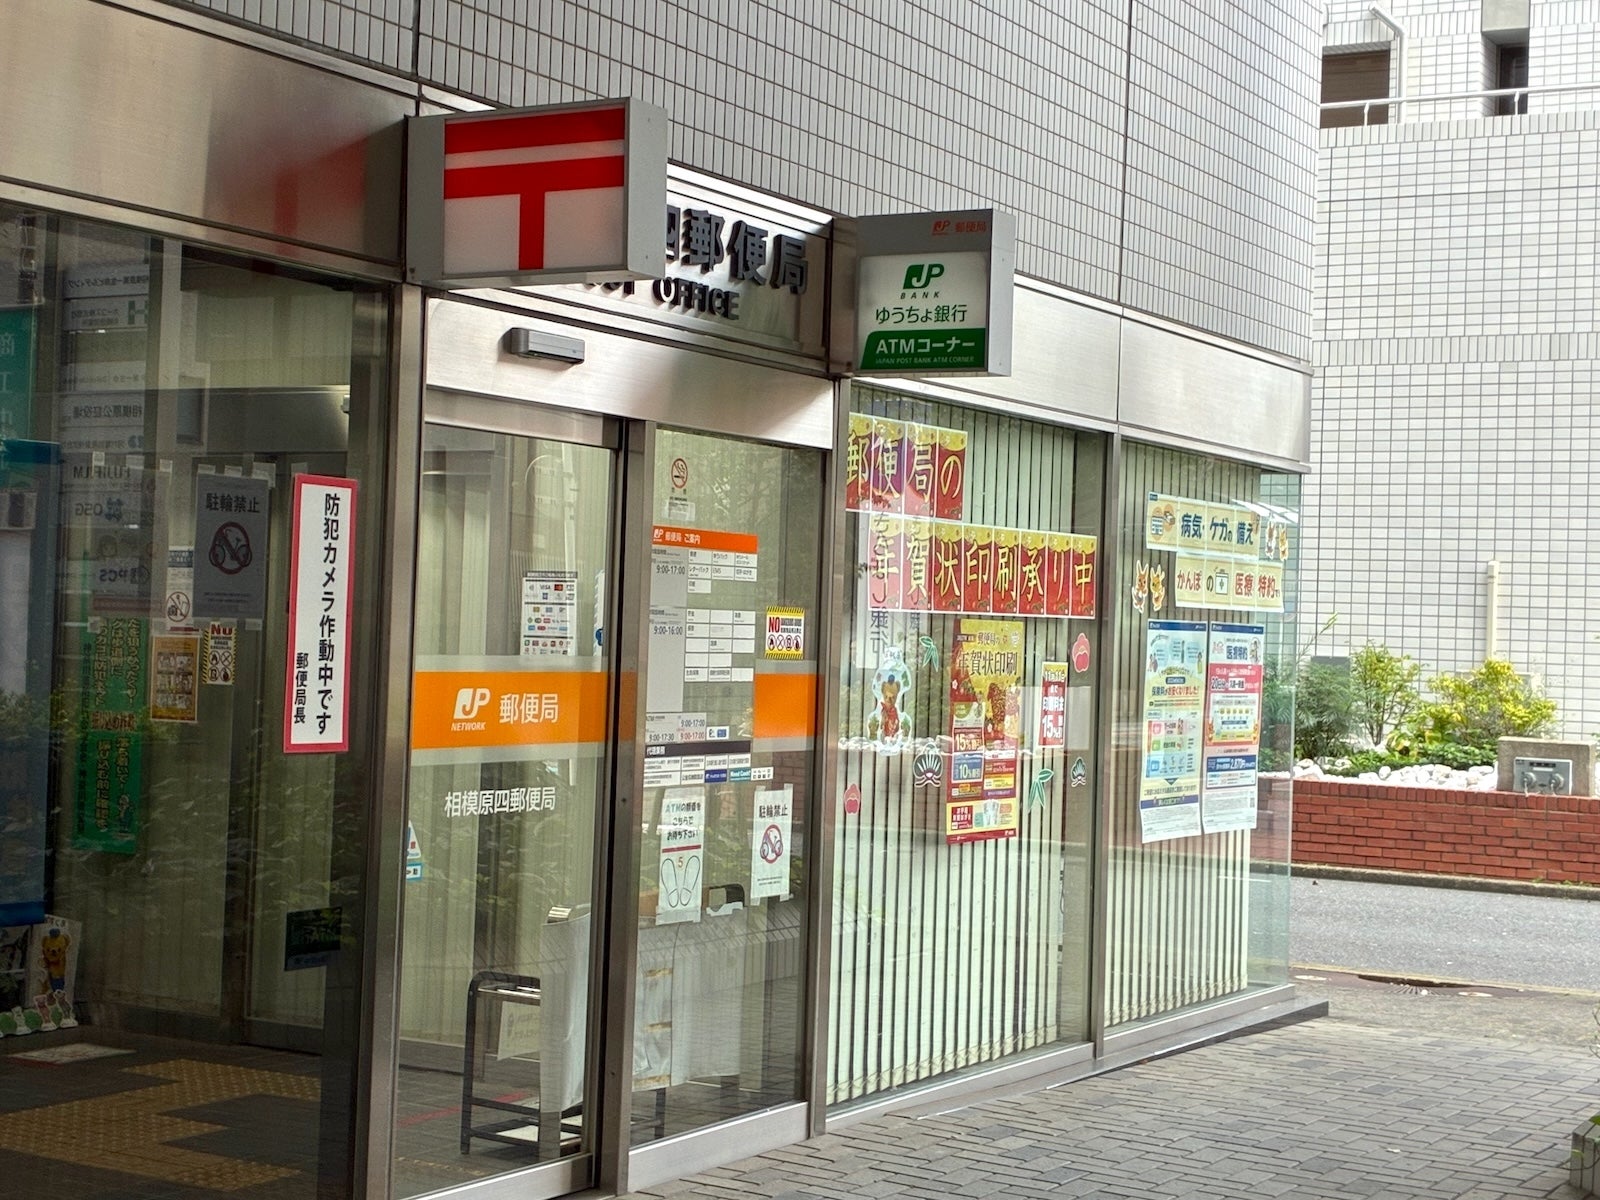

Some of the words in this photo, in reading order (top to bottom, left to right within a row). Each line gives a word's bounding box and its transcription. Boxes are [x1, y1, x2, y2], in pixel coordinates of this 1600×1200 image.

[903, 263, 945, 289] JP
[653, 277, 740, 321] OFFICE
[900, 291, 941, 300] BANK
[875, 304, 968, 325] ゆうちょ銀行
[876, 337, 975, 354] ATMコーナー
[875, 357, 895, 365] JAPAN
[896, 356, 912, 364] POST
[914, 356, 931, 364] BANK
[949, 355, 974, 363] CORNER
[846, 431, 963, 504] 郵便局の
[205, 492, 260, 514] 駐輪禁止
[656, 564, 686, 575] 9:00-17:00
[869, 535, 1095, 608] 年賀状印刷承り中
[1176, 569, 1214, 592] かんぽの
[315, 492, 341, 736] 防犯カメラ作動中です
[768, 616, 781, 633] NO
[653, 626, 683, 635] 9:00-16:00
[958, 650, 1018, 676] 年賀状印刷
[293, 651, 309, 724] 郵便局長
[453, 687, 490, 719] JP
[499, 693, 559, 724] 郵便局
[450, 721, 486, 731] NETWORK
[649, 733, 675, 742] 9:00-17:30
[444, 787, 557, 818] 相模原四郵便局
[758, 804, 789, 819] 駐輪禁止
[672, 816, 694, 826] こちらで
[667, 829, 699, 841] お待ち下さい
[677, 856, 684, 868] 5
